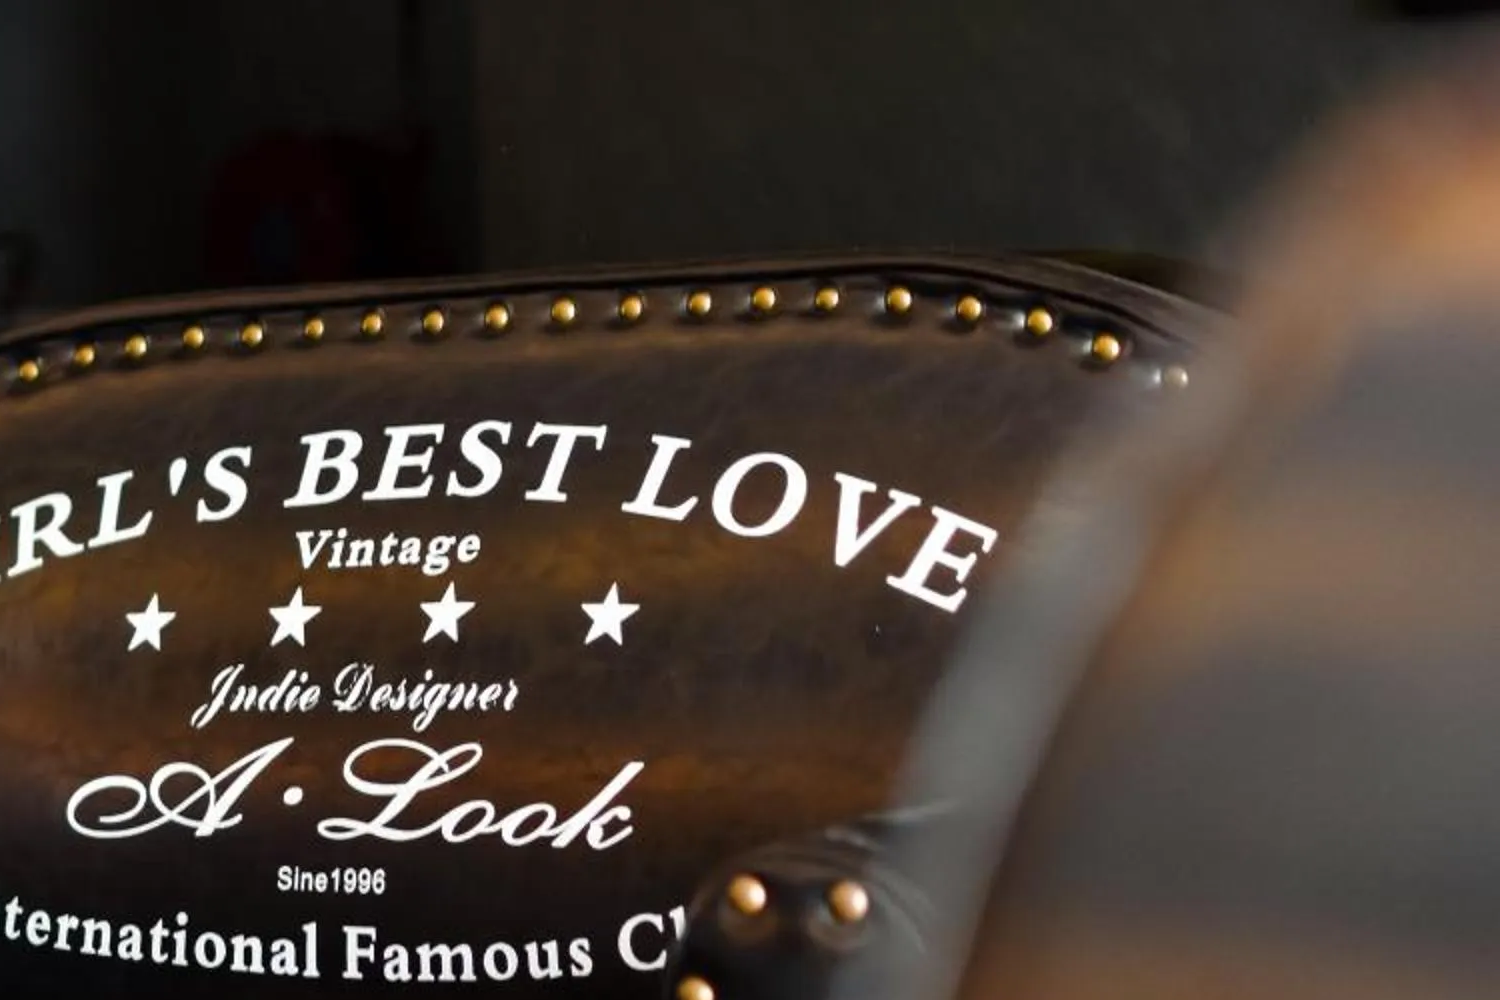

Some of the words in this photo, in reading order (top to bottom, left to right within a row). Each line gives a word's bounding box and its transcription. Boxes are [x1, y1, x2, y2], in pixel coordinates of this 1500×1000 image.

[283, 419, 608, 508] BEST
[621, 433, 999, 614] LOVE
[295, 527, 481, 577] Vintage
[190, 663, 321, 729] Indie
[332, 662, 519, 733] Designer
[342, 925, 593, 982] Famous
